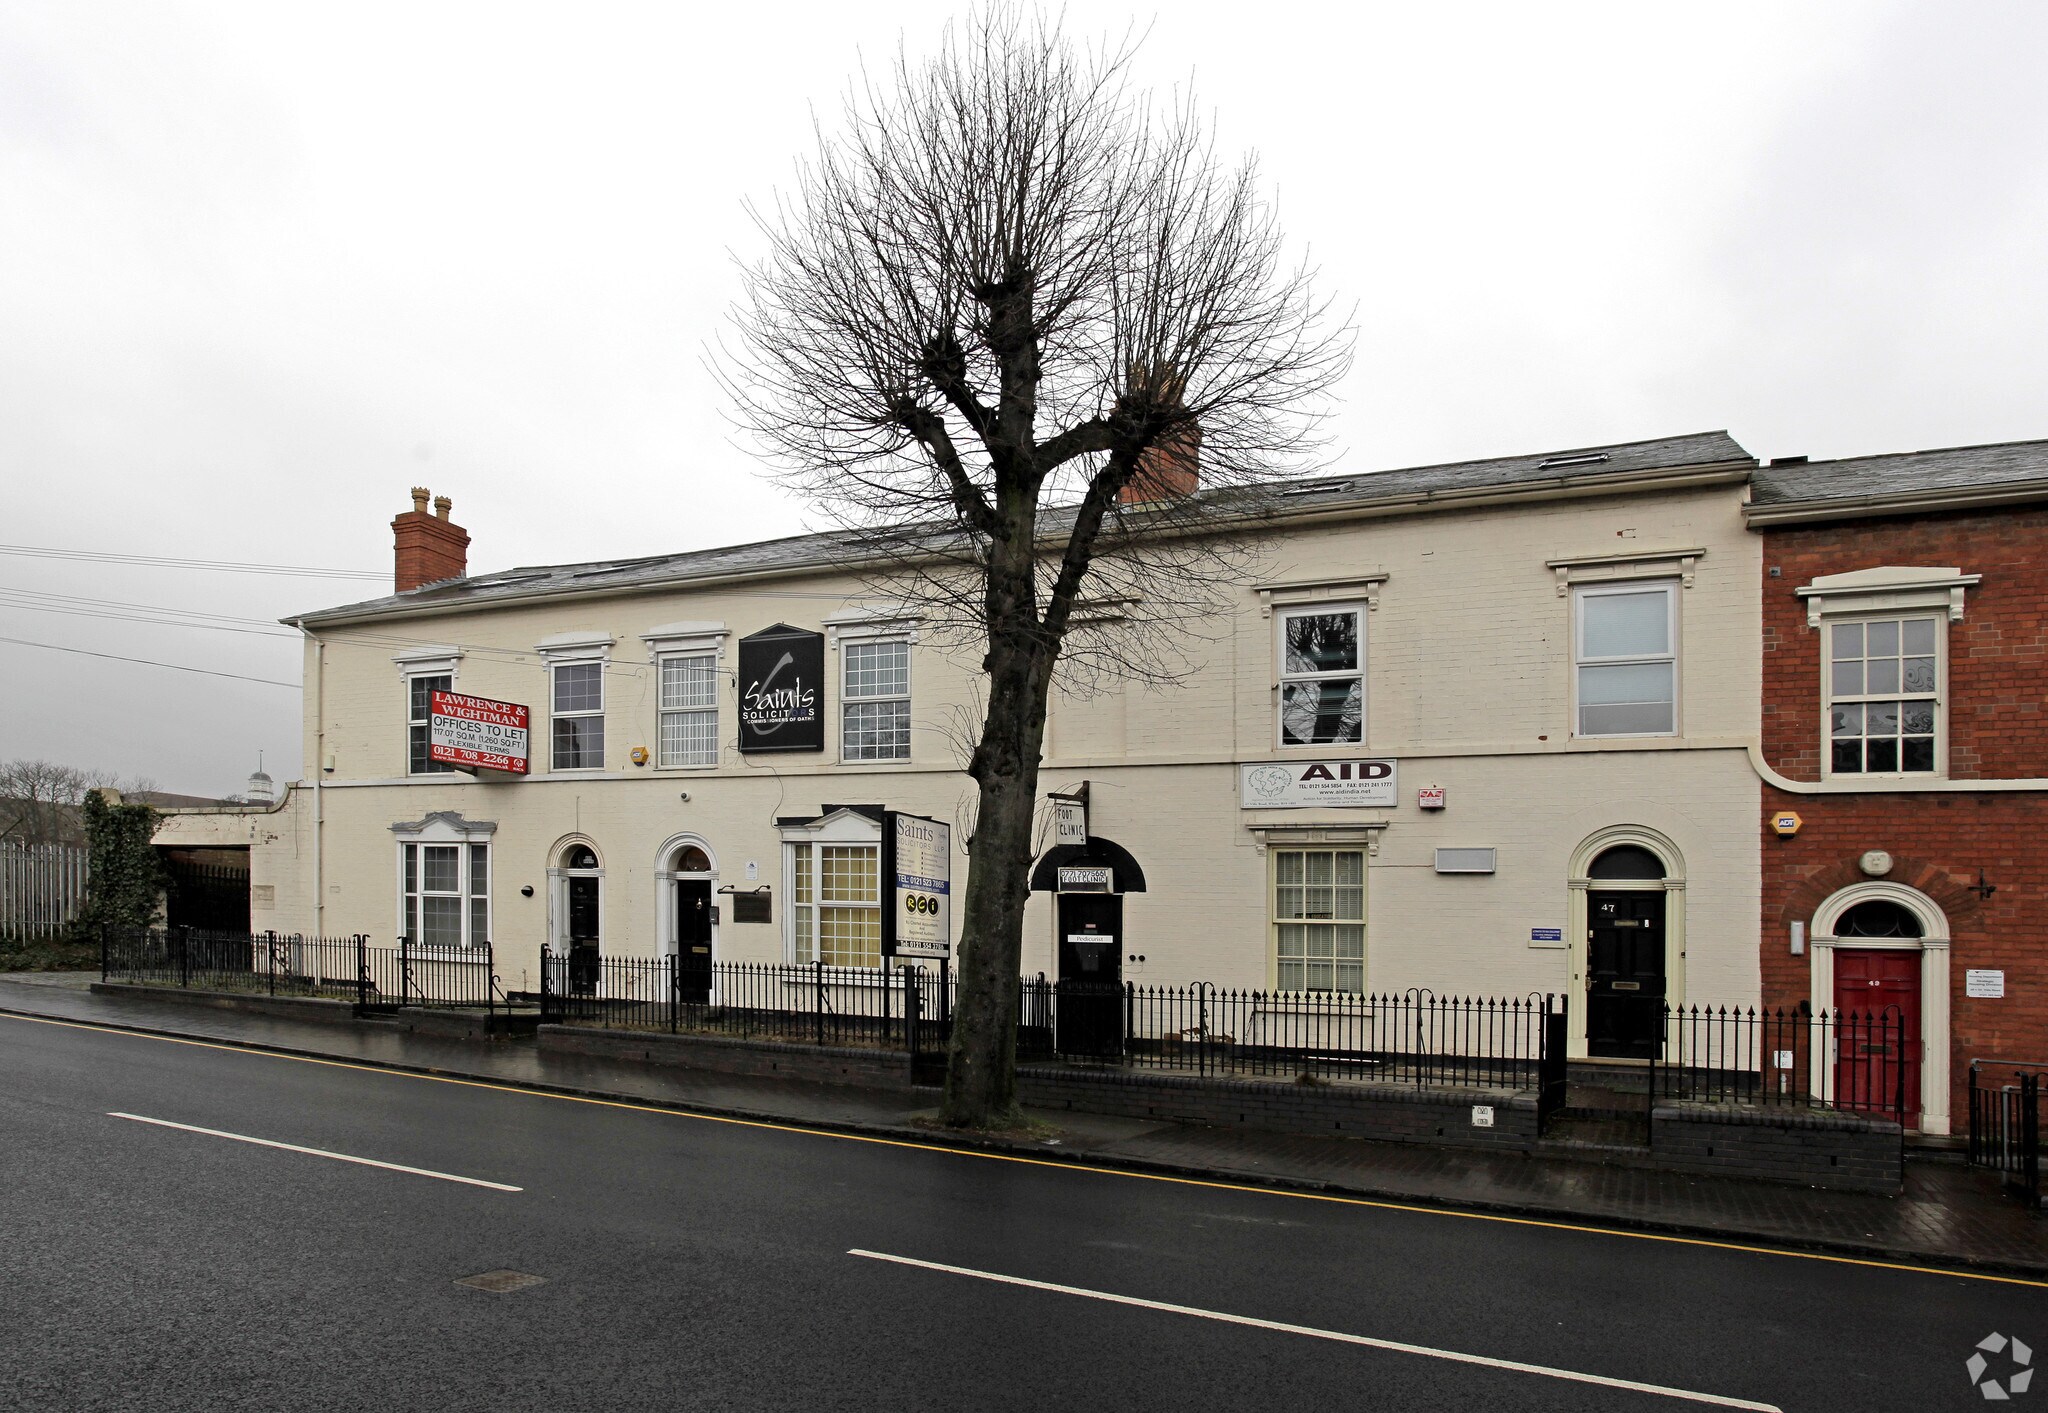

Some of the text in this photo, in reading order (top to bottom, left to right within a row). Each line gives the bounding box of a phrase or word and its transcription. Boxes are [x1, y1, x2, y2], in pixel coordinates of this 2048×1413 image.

[743, 677, 815, 711] Saints
[435, 692, 526, 717] LAWRENCE &
[442, 705, 520, 726] WIGHTMAN
[742, 708, 816, 720] SOLICITORS
[434, 716, 525, 740] OFFICES TO LET
[434, 728, 454, 738] 117.07
[449, 739, 510, 755] FLEXIBLE TERMS
[434, 746, 509, 765] 0121 708 2266
[1300, 763, 1392, 781] AID
[1058, 809, 1072, 820] FOOT
[898, 818, 934, 842] Saints
[1060, 824, 1083, 836] CLINIC
[897, 837, 932, 850] SOLICITORS
[898, 874, 909, 883] TEL:
[910, 877, 922, 886] 0121
[922, 878, 932, 887] 523
[1601, 903, 1615, 913] 47
